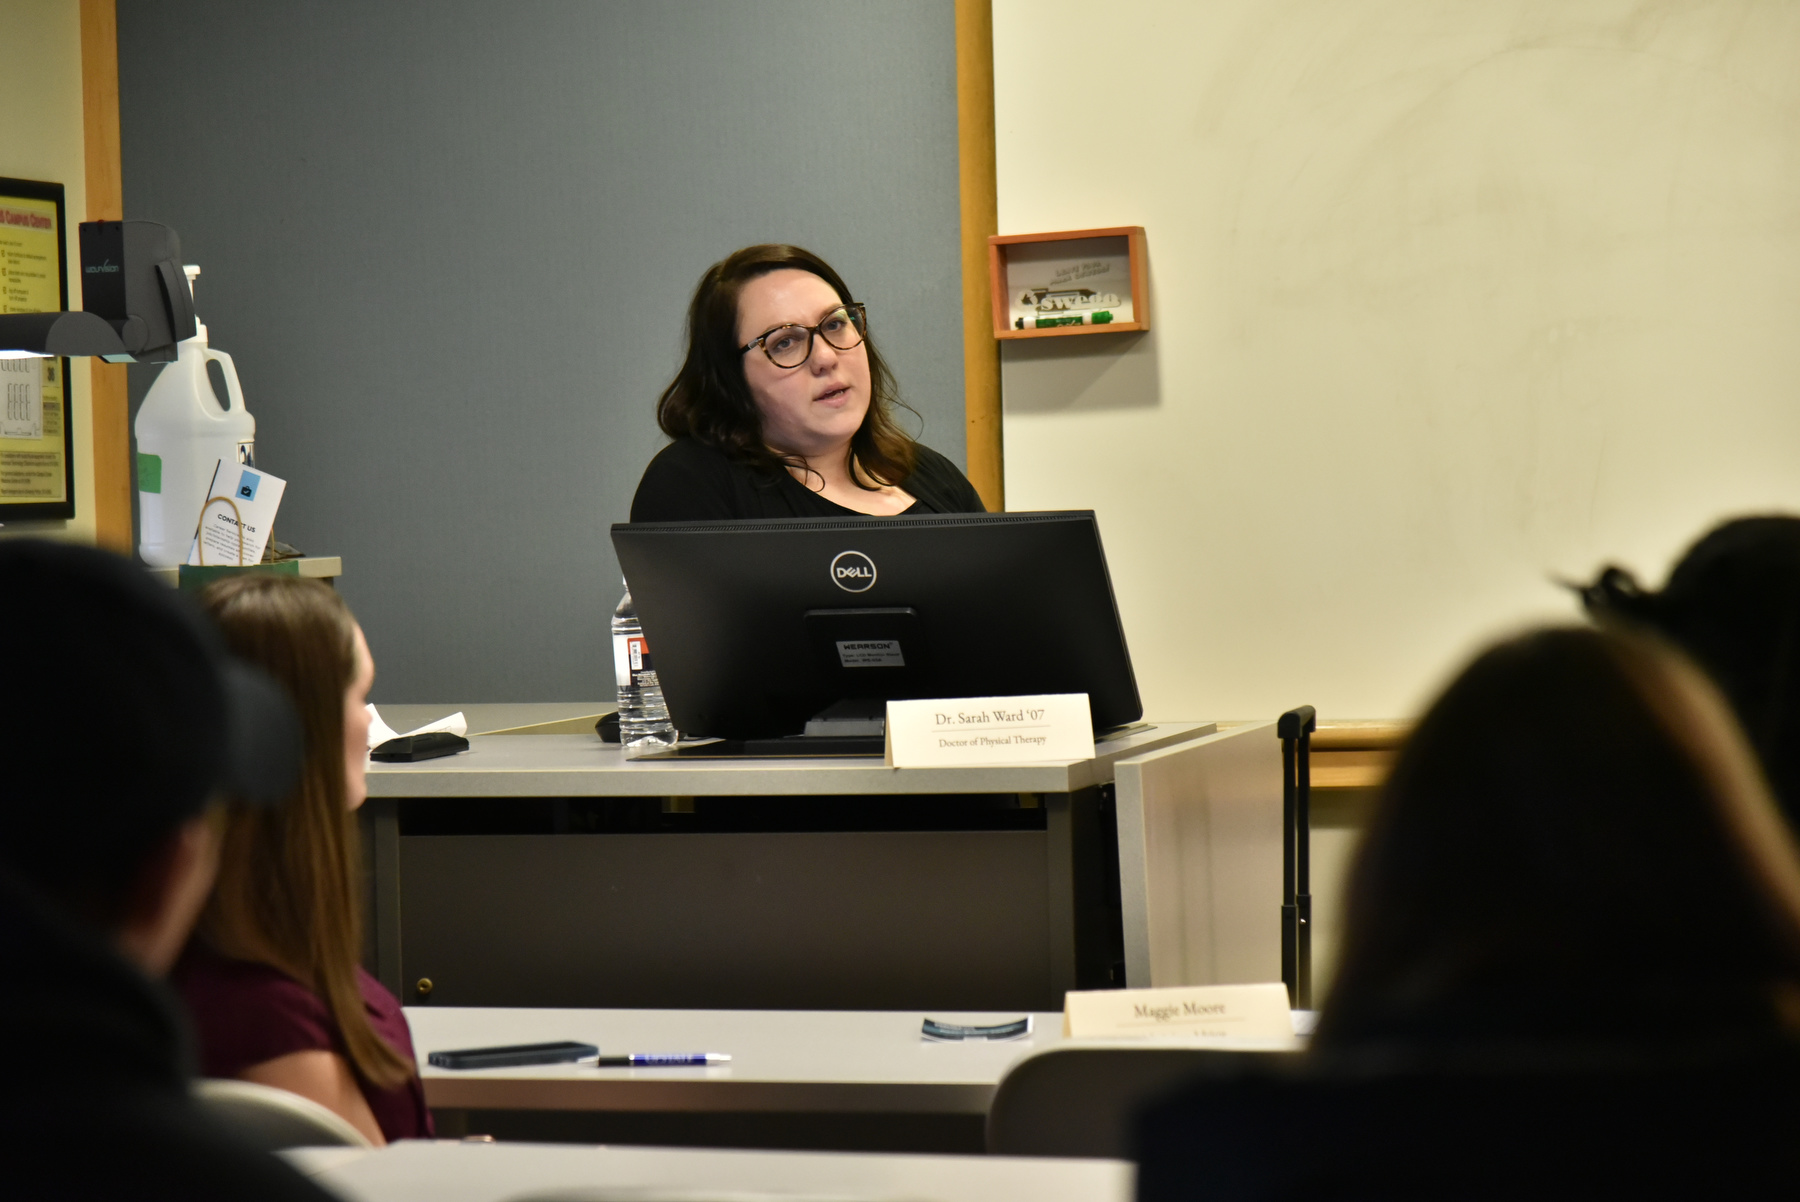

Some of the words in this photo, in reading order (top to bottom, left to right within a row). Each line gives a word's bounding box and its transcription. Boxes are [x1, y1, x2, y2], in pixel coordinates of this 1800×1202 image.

[217, 513, 246, 529] CONTAT
[247, 525, 256, 533] US
[836, 566, 872, 578] DELL
[935, 713, 955, 725] Dr.
[958, 711, 990, 724] Sarah
[993, 709, 1024, 722] Ward
[938, 739, 967, 748] Doctor
[970, 737, 979, 746] of
[980, 736, 1011, 747] Physical
[1013, 735, 1047, 746] Therapy
[1134, 1003, 1180, 1022] Maggie
[1183, 1002, 1225, 1016] Moore
